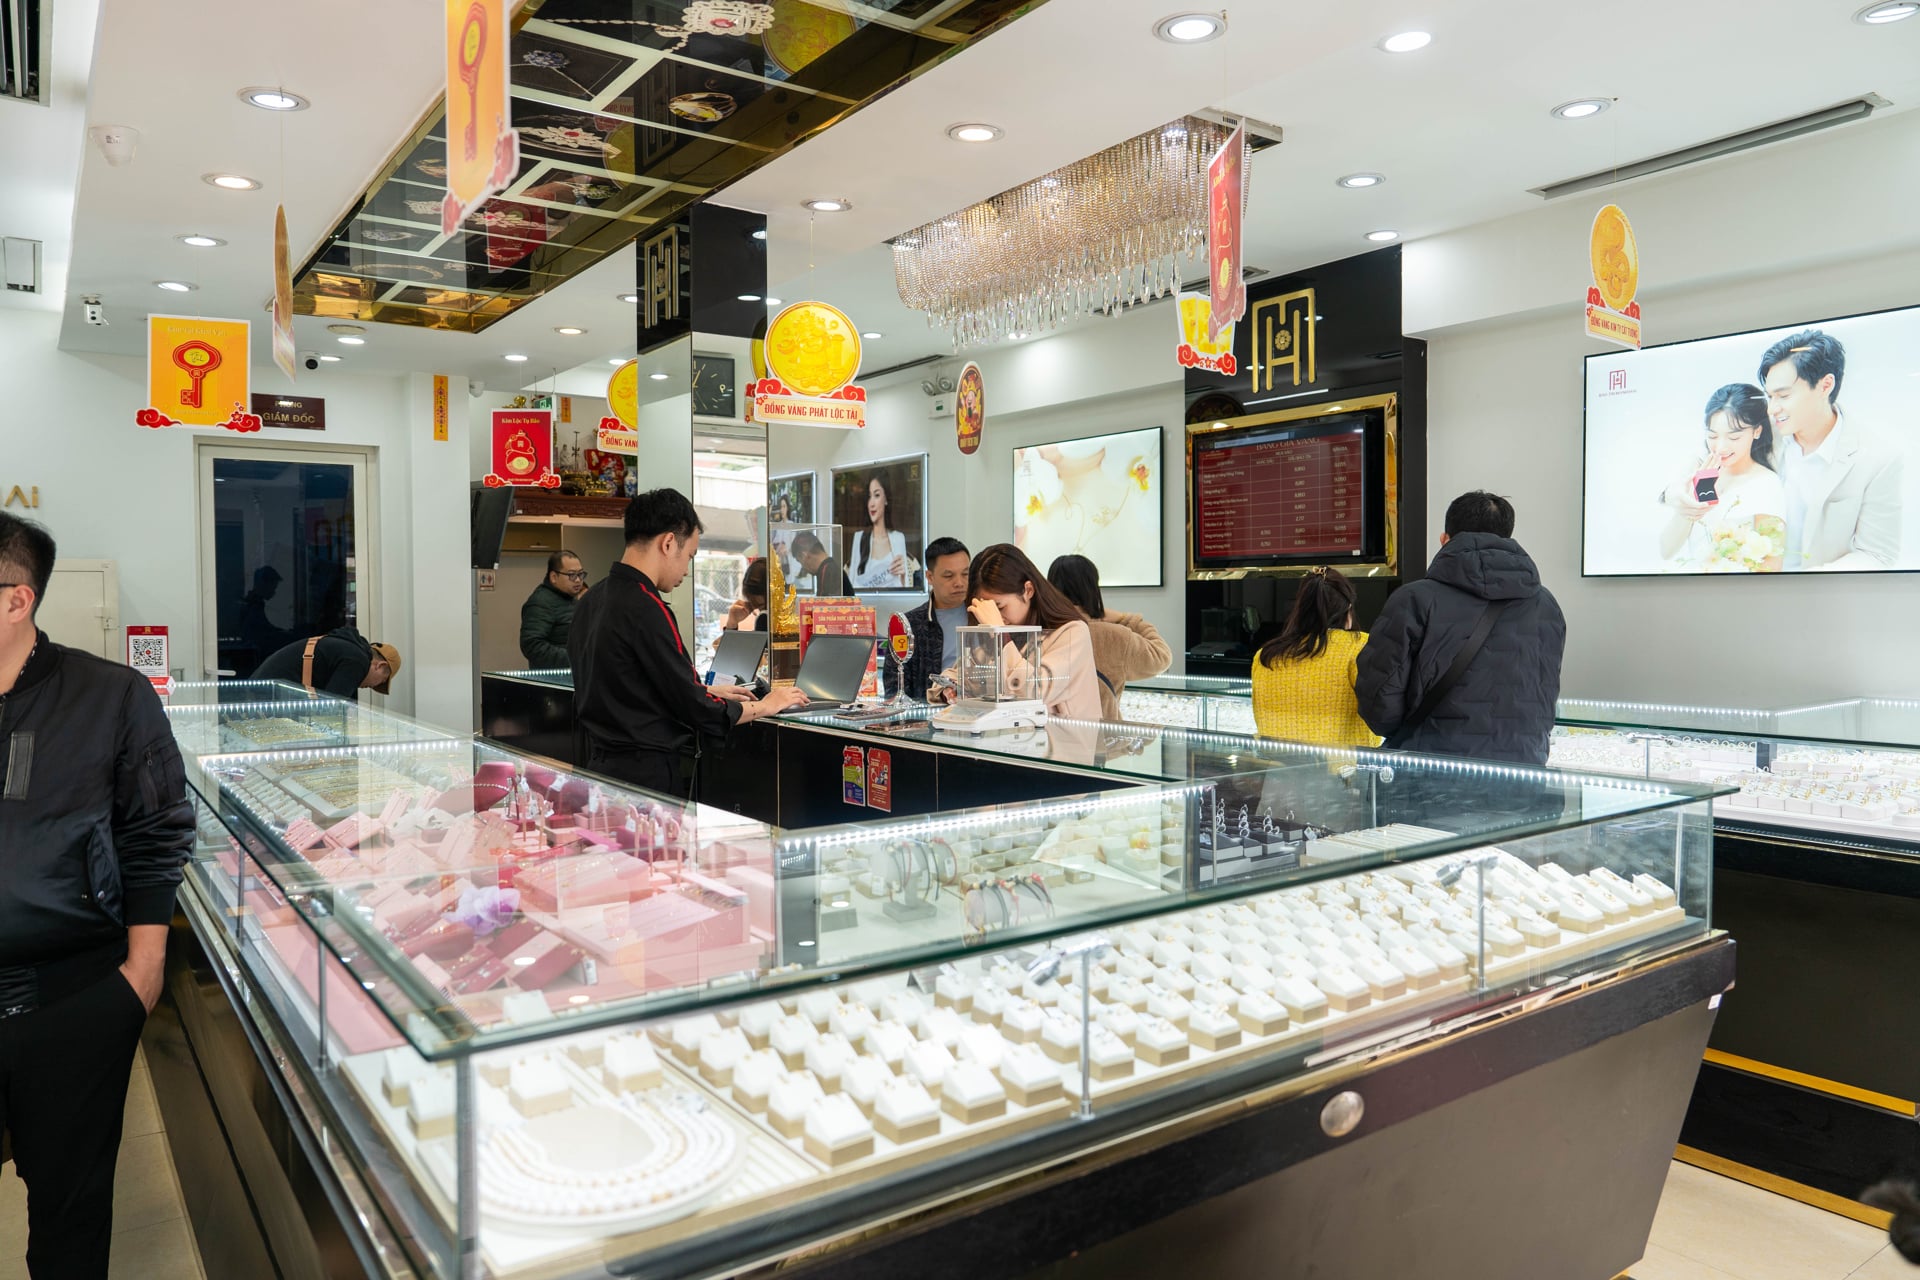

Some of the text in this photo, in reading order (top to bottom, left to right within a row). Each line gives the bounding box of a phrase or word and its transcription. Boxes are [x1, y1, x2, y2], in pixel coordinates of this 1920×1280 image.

[263, 411, 315, 423] GIÁM ĐỐC
[764, 401, 858, 420] ĐỒNG VÀNG PHÁT LỘC TÀI
